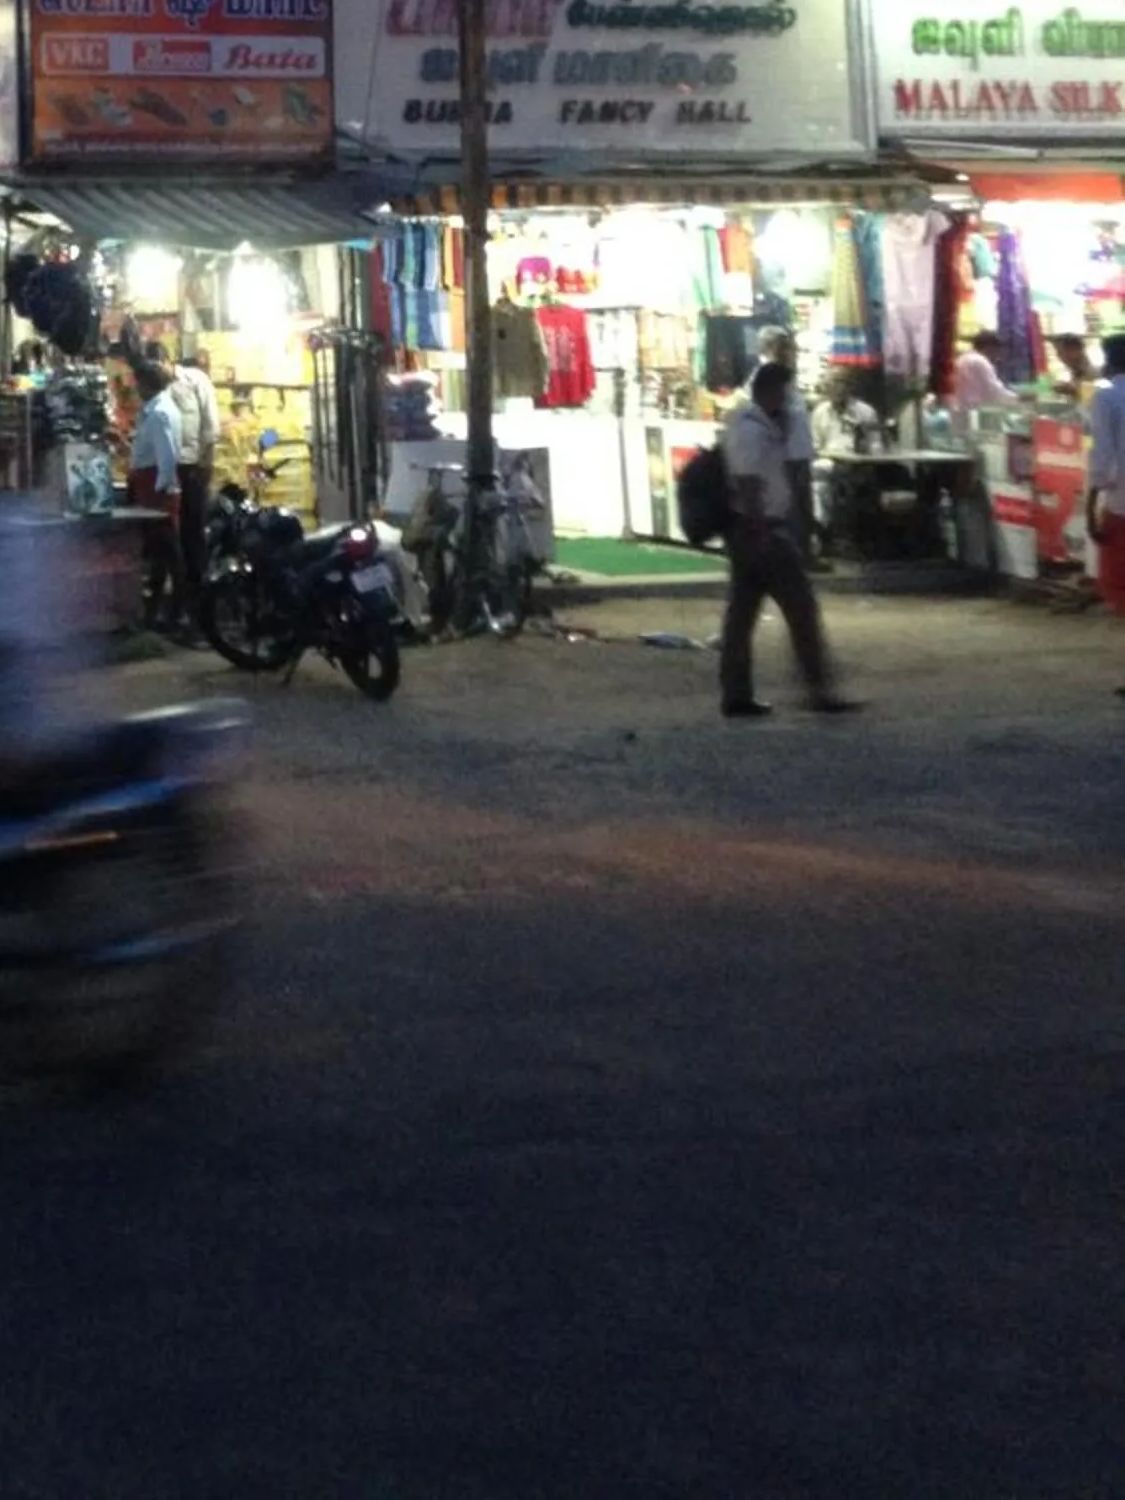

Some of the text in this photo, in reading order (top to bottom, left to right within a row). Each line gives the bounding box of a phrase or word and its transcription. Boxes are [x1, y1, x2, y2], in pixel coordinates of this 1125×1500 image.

[223, 43, 318, 70] Bata
[403, 100, 752, 125] BURA FANCY HALL
[893, 78, 1039, 120] MALAYA
